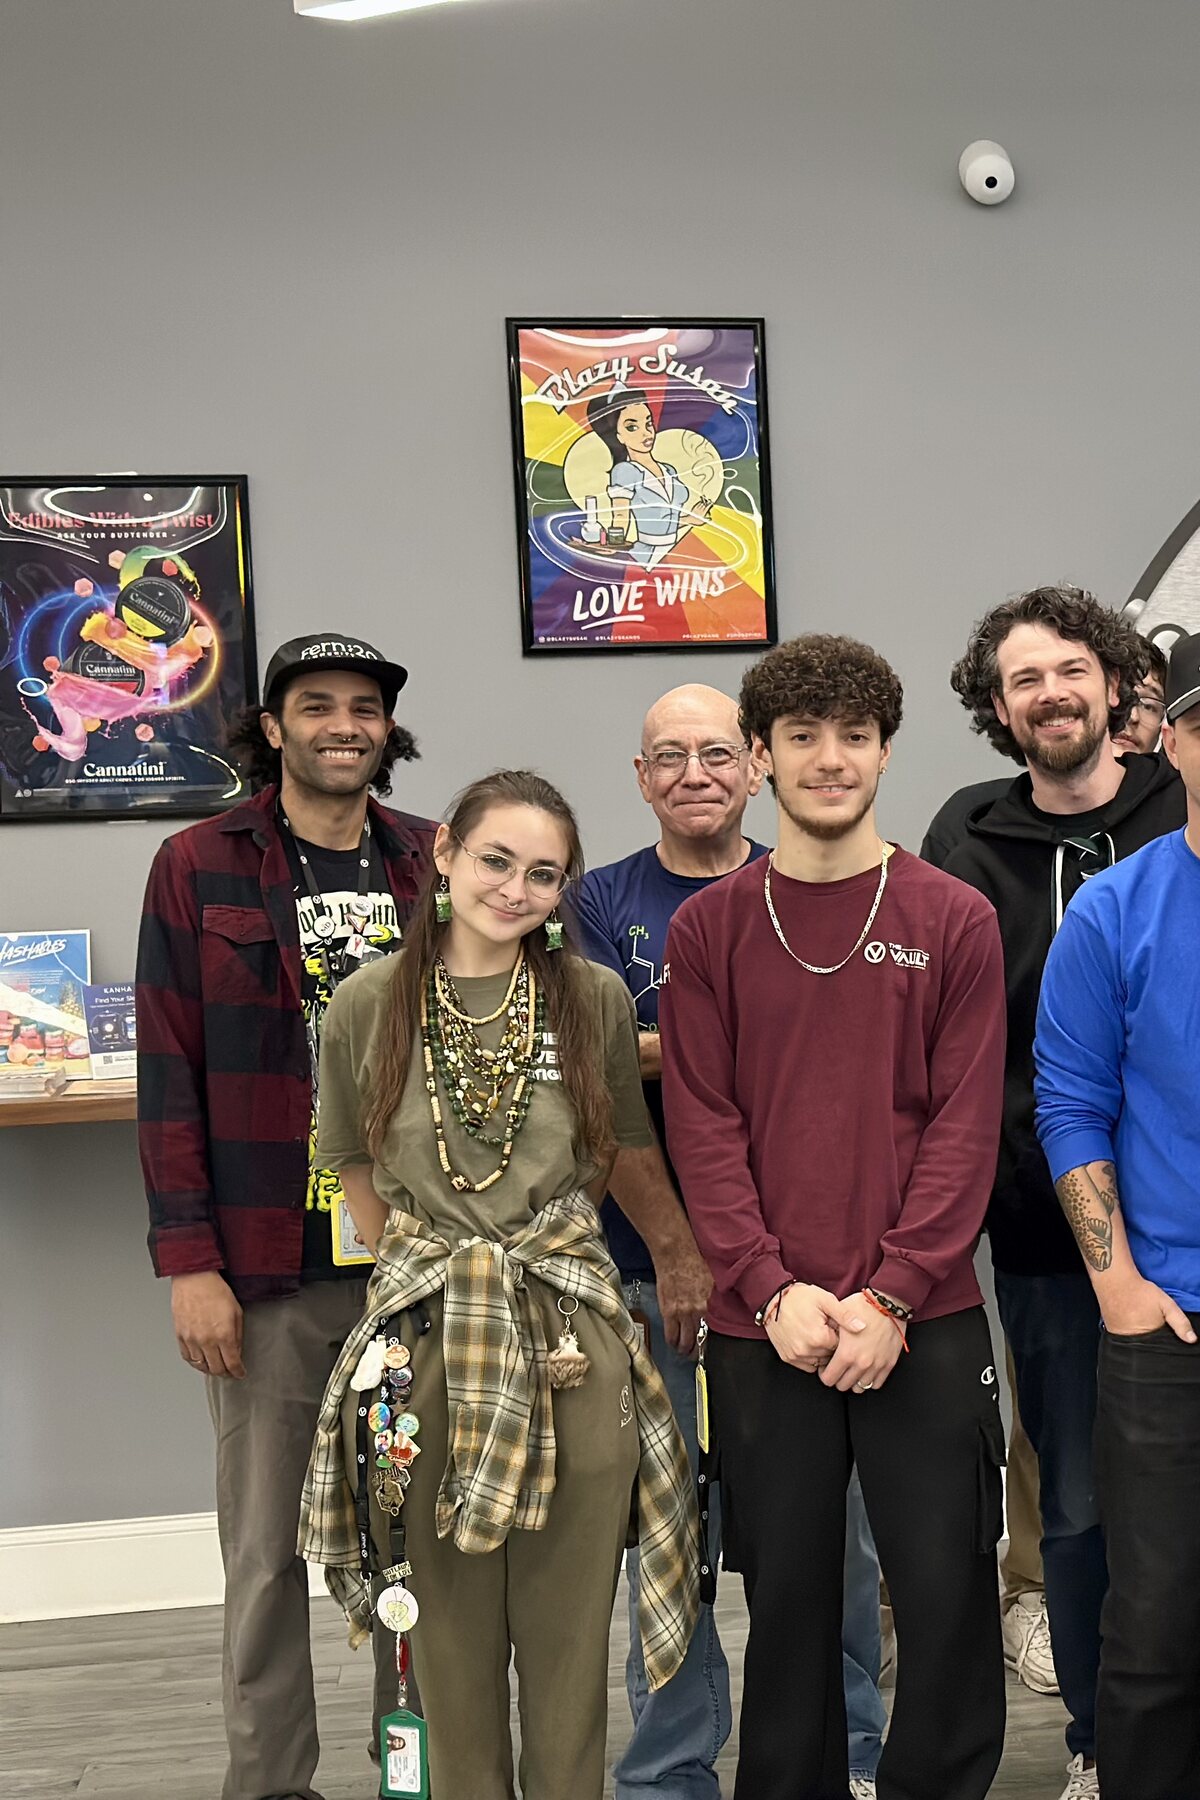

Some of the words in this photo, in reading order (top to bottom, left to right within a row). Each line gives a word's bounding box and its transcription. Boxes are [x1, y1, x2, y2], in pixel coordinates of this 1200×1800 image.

[535, 356, 635, 415] Blazy
[639, 343, 738, 415] Susan
[8, 511, 84, 528] Edibles
[573, 580, 647, 621] LOVE
[654, 568, 726, 607] WINS
[86, 664, 136, 675] Cannatini
[83, 761, 165, 777] Cannatini
[889, 949, 930, 968] VAULT
[103, 986, 133, 994] KANHA
